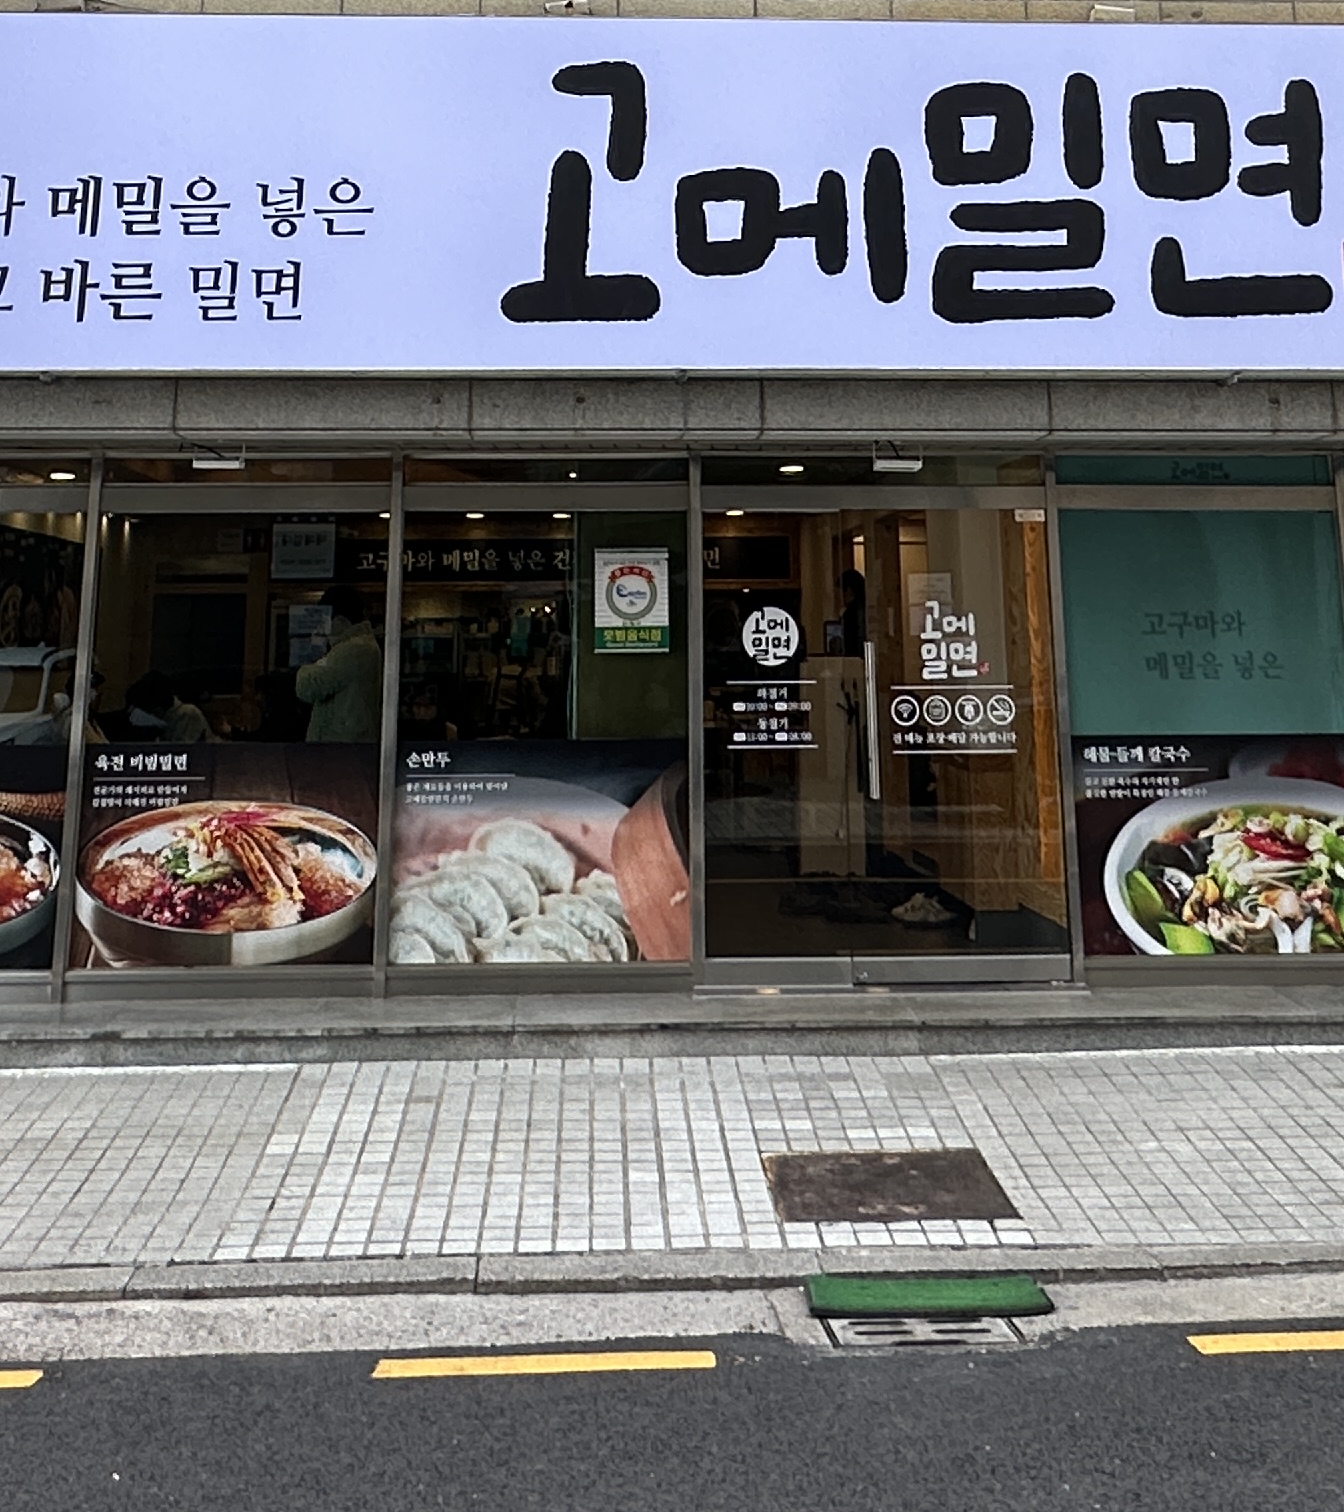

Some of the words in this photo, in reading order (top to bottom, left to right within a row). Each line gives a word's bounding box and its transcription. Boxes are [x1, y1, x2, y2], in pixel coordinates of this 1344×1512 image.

[46, 175, 233, 239] 메밀을
[256, 177, 376, 239] 넣은
[501, 59, 1333, 323] 고메밀면
[40, 258, 163, 322] 바른
[193, 259, 304, 322] 밀면
[442, 549, 500, 571] 메밀을
[920, 600, 976, 639] 고메
[1141, 609, 1246, 638] 고구마와
[751, 635, 792, 661] 밀면
[921, 640, 978, 680] 밀면
[1144, 650, 1223, 680] 메밀을
[1233, 650, 1285, 681] 넣은
[406, 751, 451, 768] 손만두
